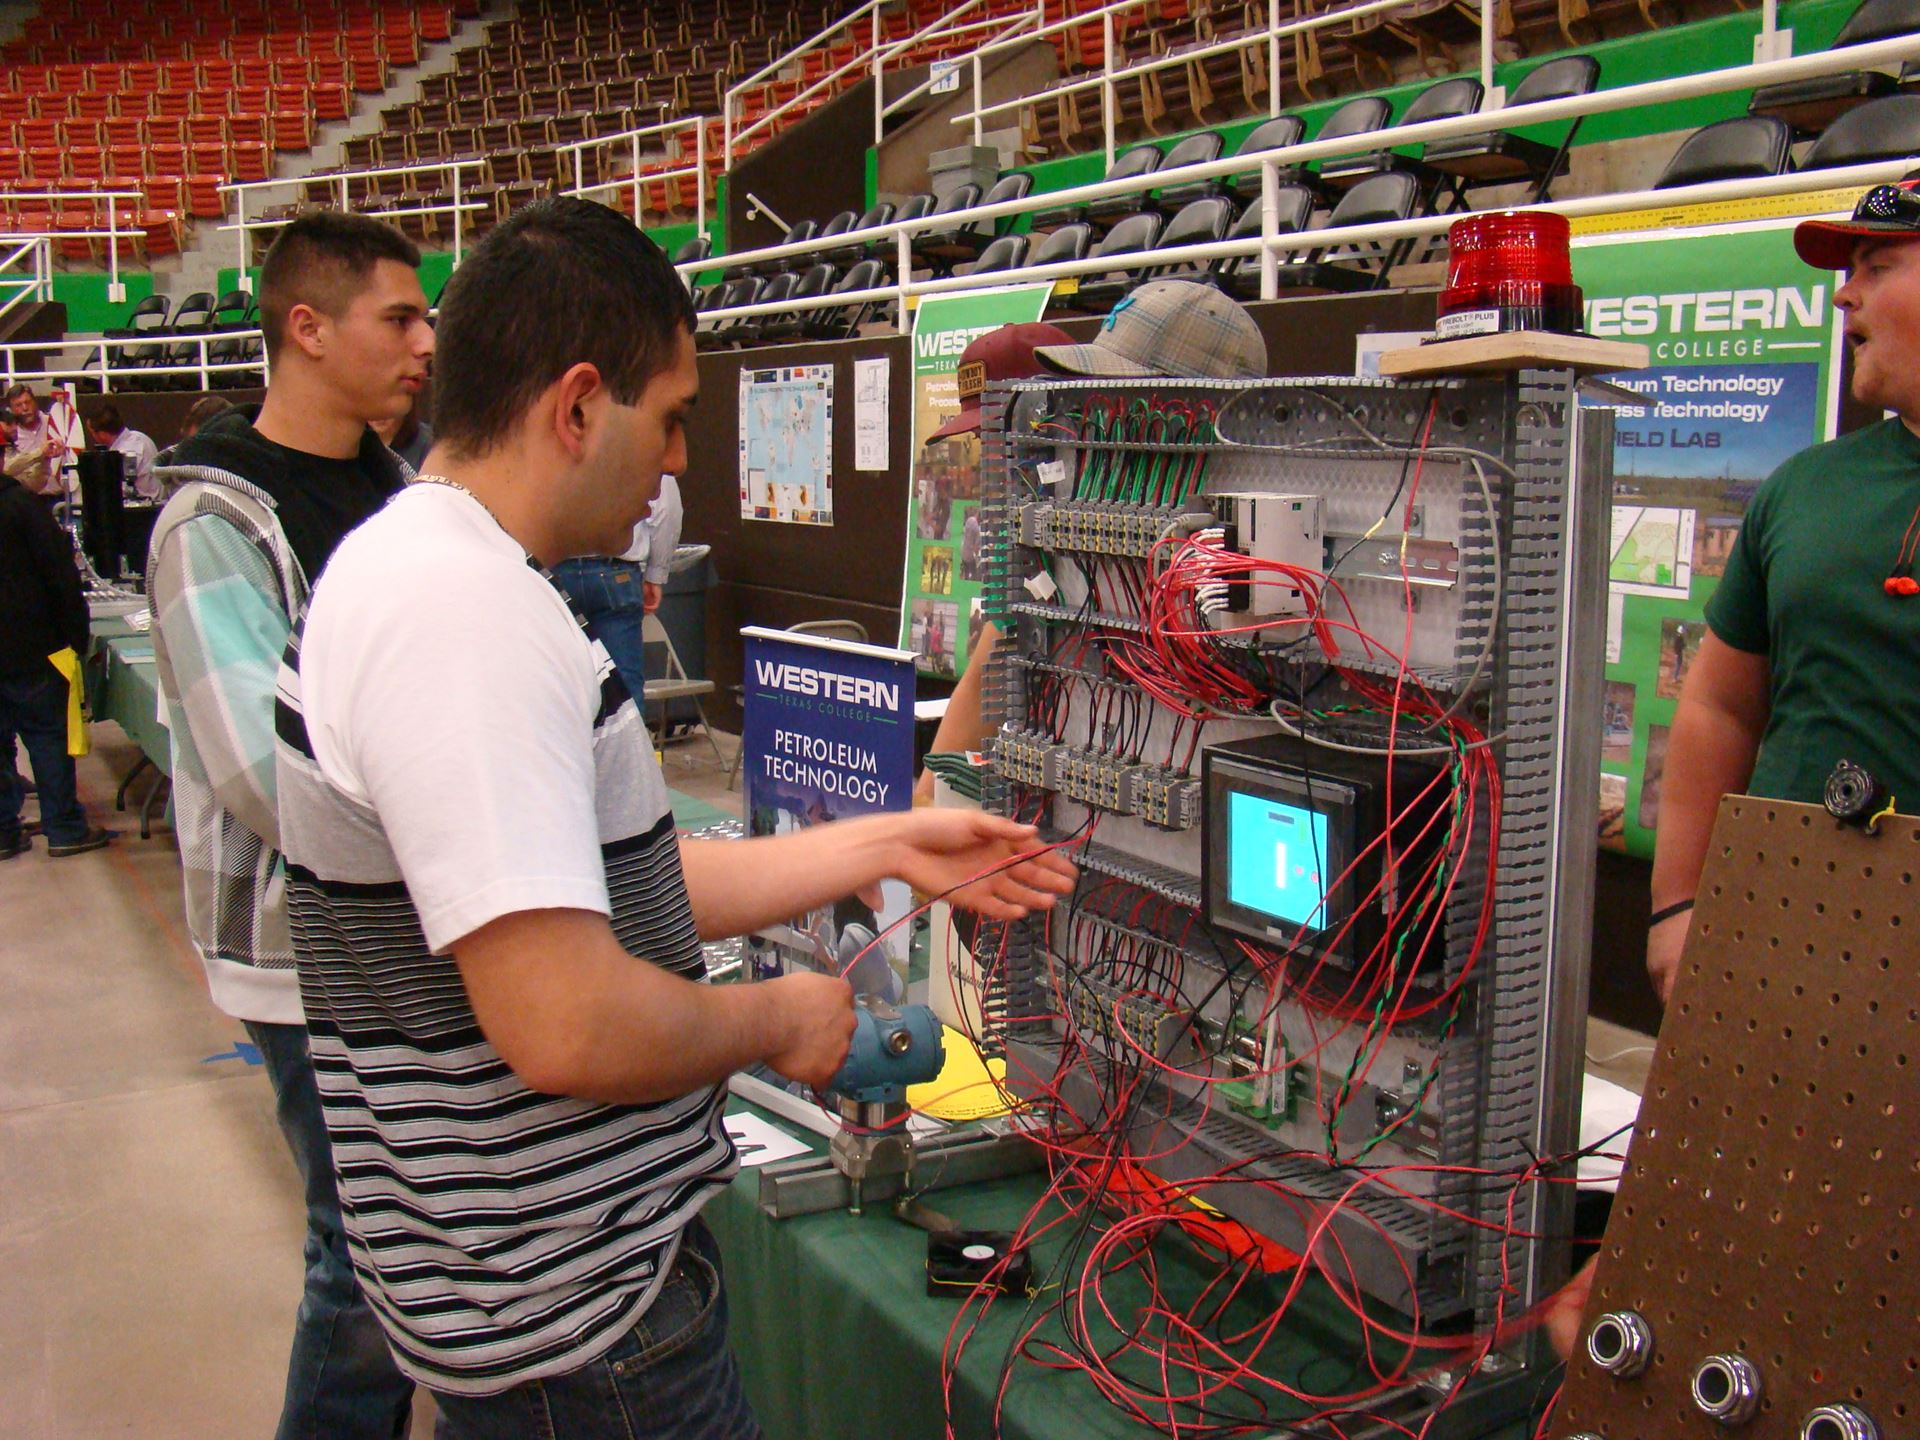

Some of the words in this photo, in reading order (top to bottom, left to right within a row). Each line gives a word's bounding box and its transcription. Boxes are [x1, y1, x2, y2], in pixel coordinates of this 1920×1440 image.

[1475, 312, 1495, 321] PLUS
[1583, 285, 1825, 337] ESTERN
[917, 325, 1003, 358] WEST
[1656, 339, 1763, 359] COLLEGE
[1662, 374, 1784, 396] Technology
[1653, 401, 1769, 423] Technology
[1615, 431, 1664, 448] IELD
[1670, 428, 1722, 448] LAB
[755, 659, 899, 712] WESTERN
[779, 694, 811, 711] TEXAS
[818, 702, 871, 723] COLLEGE
[775, 729, 877, 774] PETROLEUM
[764, 754, 889, 806] TECHNOLOGY
